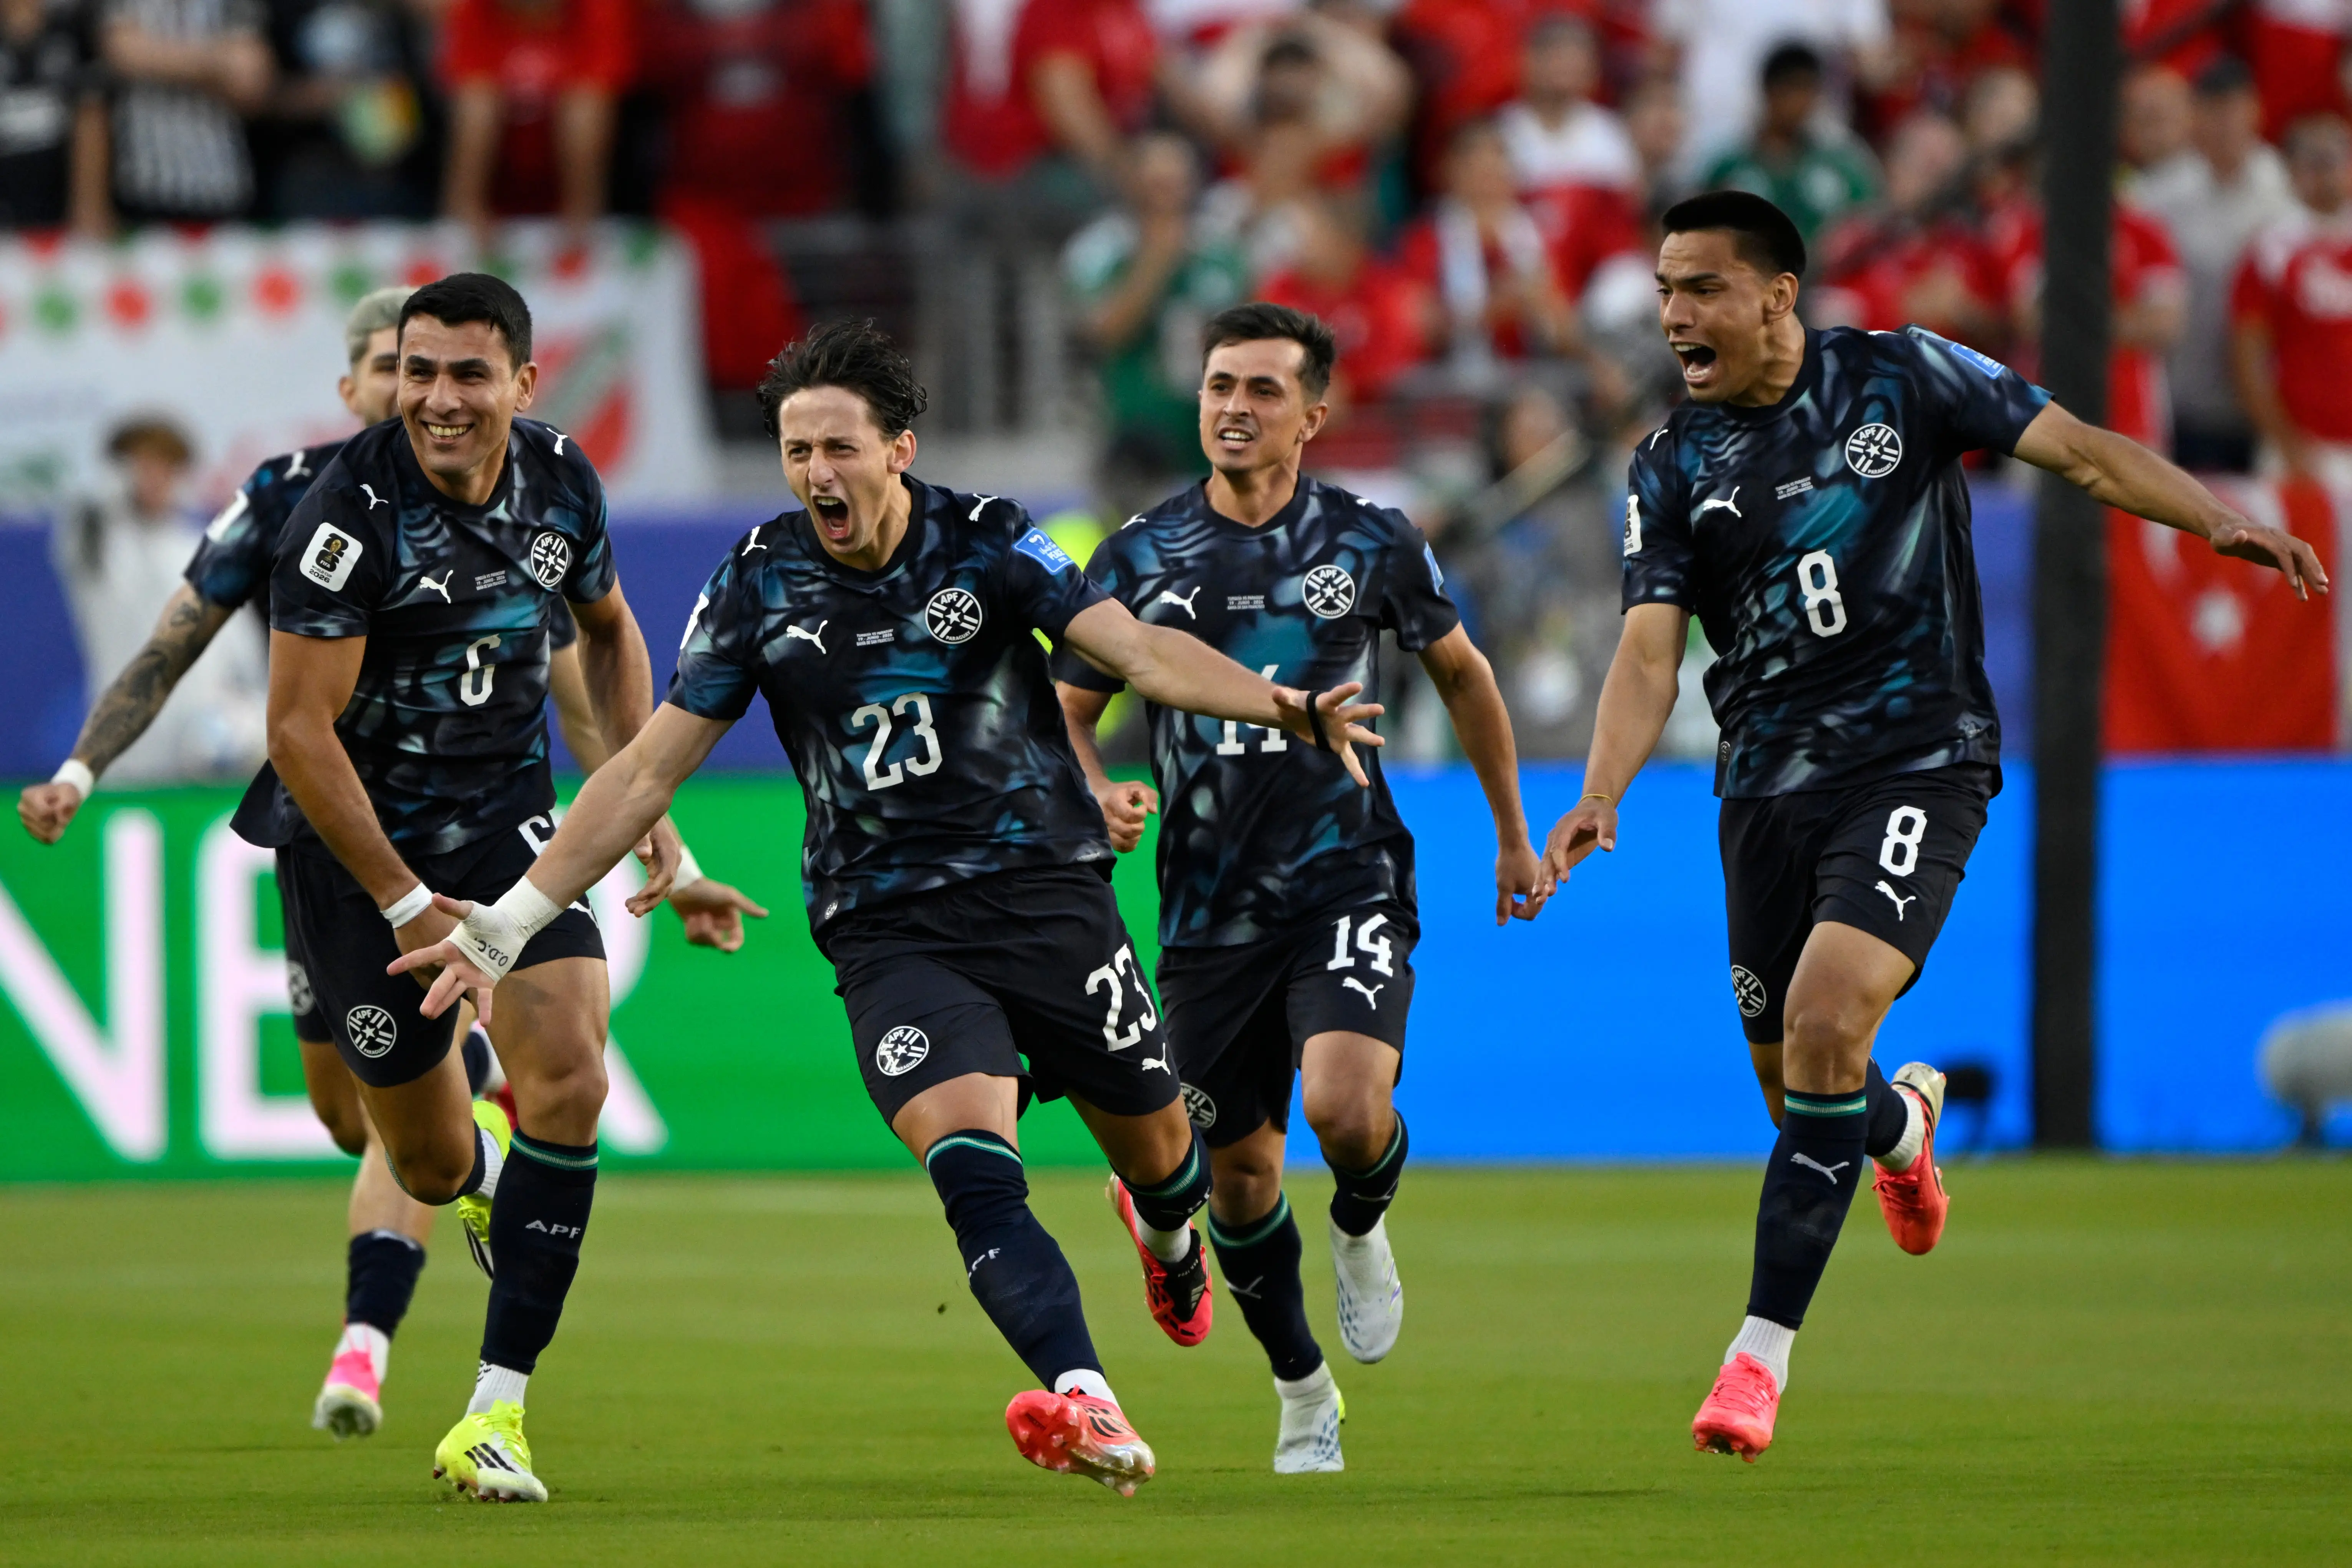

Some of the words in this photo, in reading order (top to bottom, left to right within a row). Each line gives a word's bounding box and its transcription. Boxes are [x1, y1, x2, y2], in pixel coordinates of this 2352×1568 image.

[1859, 426, 1876, 440] APF
[1868, 462, 1892, 474] PARAGUAY
[541, 535, 553, 548] APF
[312, 565, 324, 574] WORLD
[320, 560, 330, 568] FIFA
[309, 569, 330, 583] 2026
[545, 573, 561, 583] PARAGUAY
[1320, 569, 1337, 578] APF
[941, 592, 958, 604] APF
[1797, 549, 1847, 637] 8
[946, 631, 971, 641] PARAGUAY
[461, 634, 501, 706] 6
[851, 691, 942, 791] 23
[1879, 805, 1927, 876] 8
[1327, 913, 1393, 977] 14
[1735, 969, 1745, 979] APF
[1085, 943, 1157, 1052] 23
[356, 1009, 372, 1019] APF
[888, 1029, 904, 1044] APF
[364, 1045, 386, 1054] PARAGUAY
[525, 1220, 581, 1238] APF
